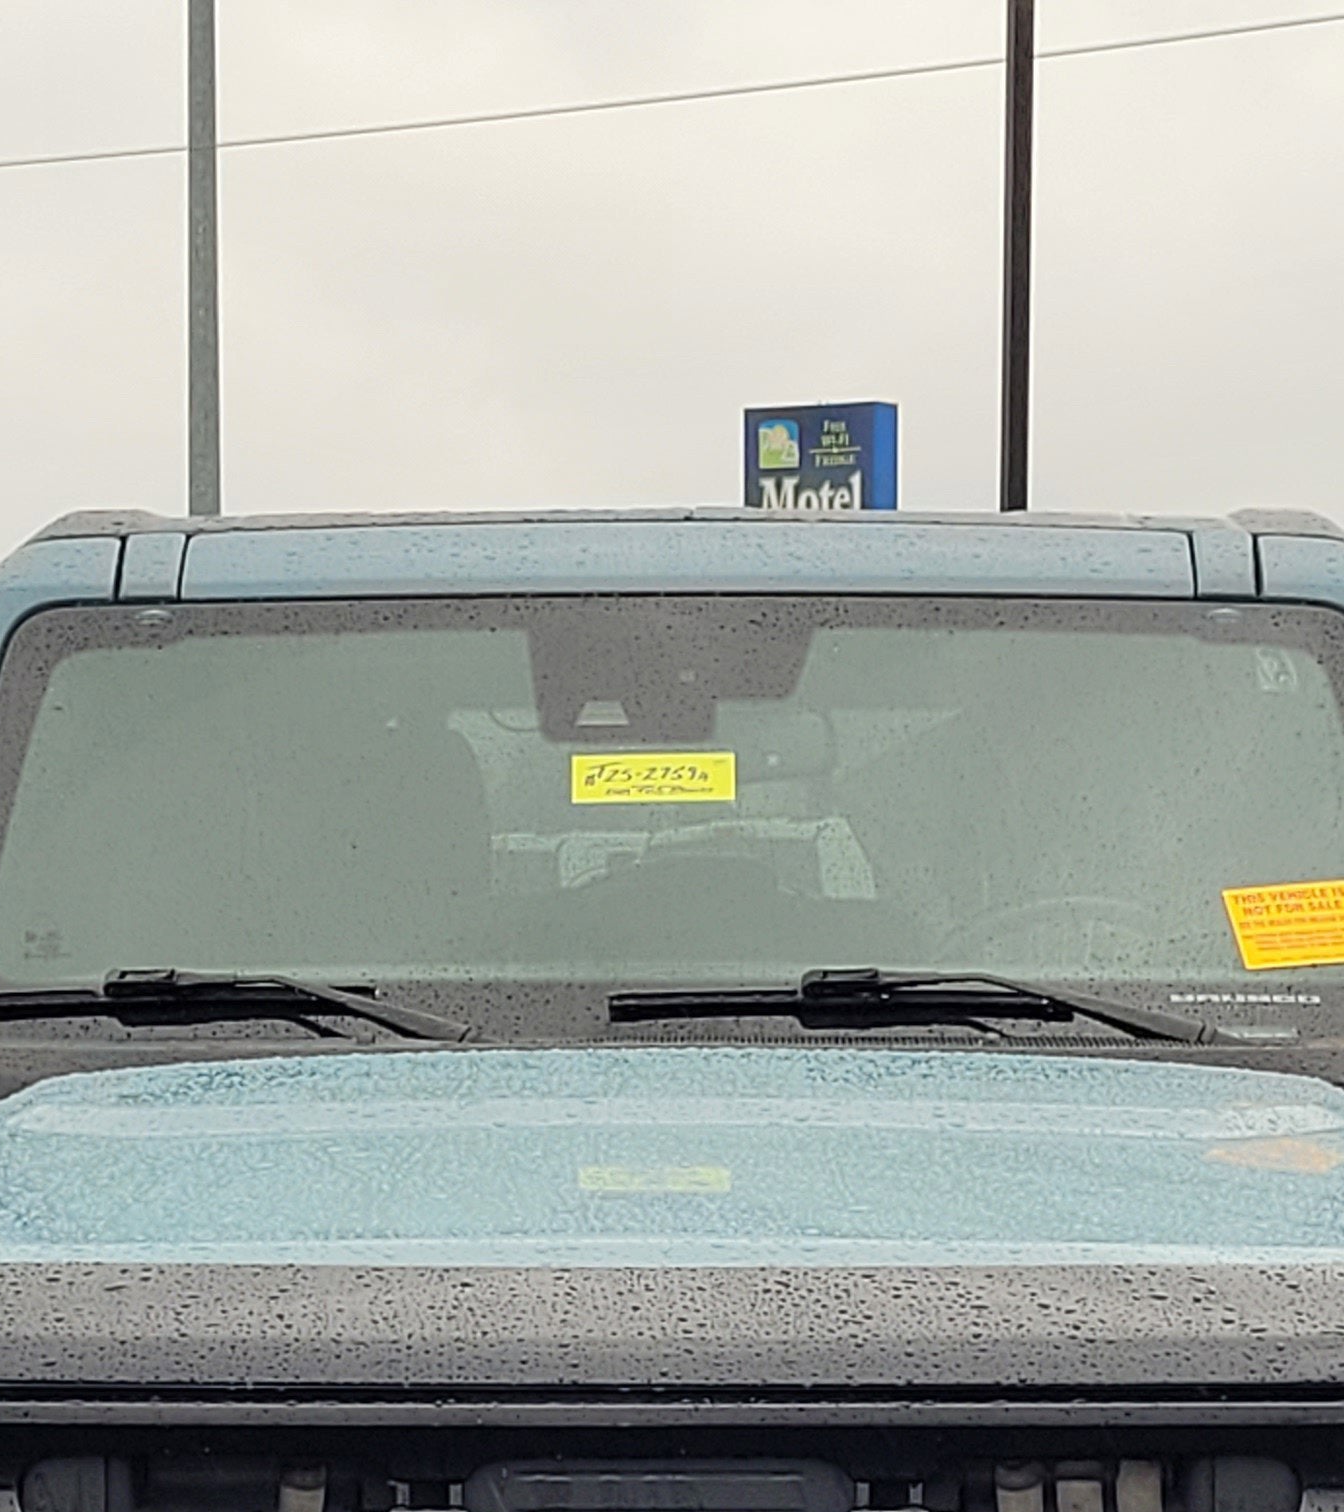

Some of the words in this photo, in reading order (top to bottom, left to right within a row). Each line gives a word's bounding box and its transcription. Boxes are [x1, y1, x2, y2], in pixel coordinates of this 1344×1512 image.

[758, 470, 862, 511] Motel
[1268, 887, 1328, 901] VEHICLE
[1243, 903, 1273, 916] NOT
[1275, 902, 1306, 914] FOR
[1309, 900, 1343, 912] SALE
